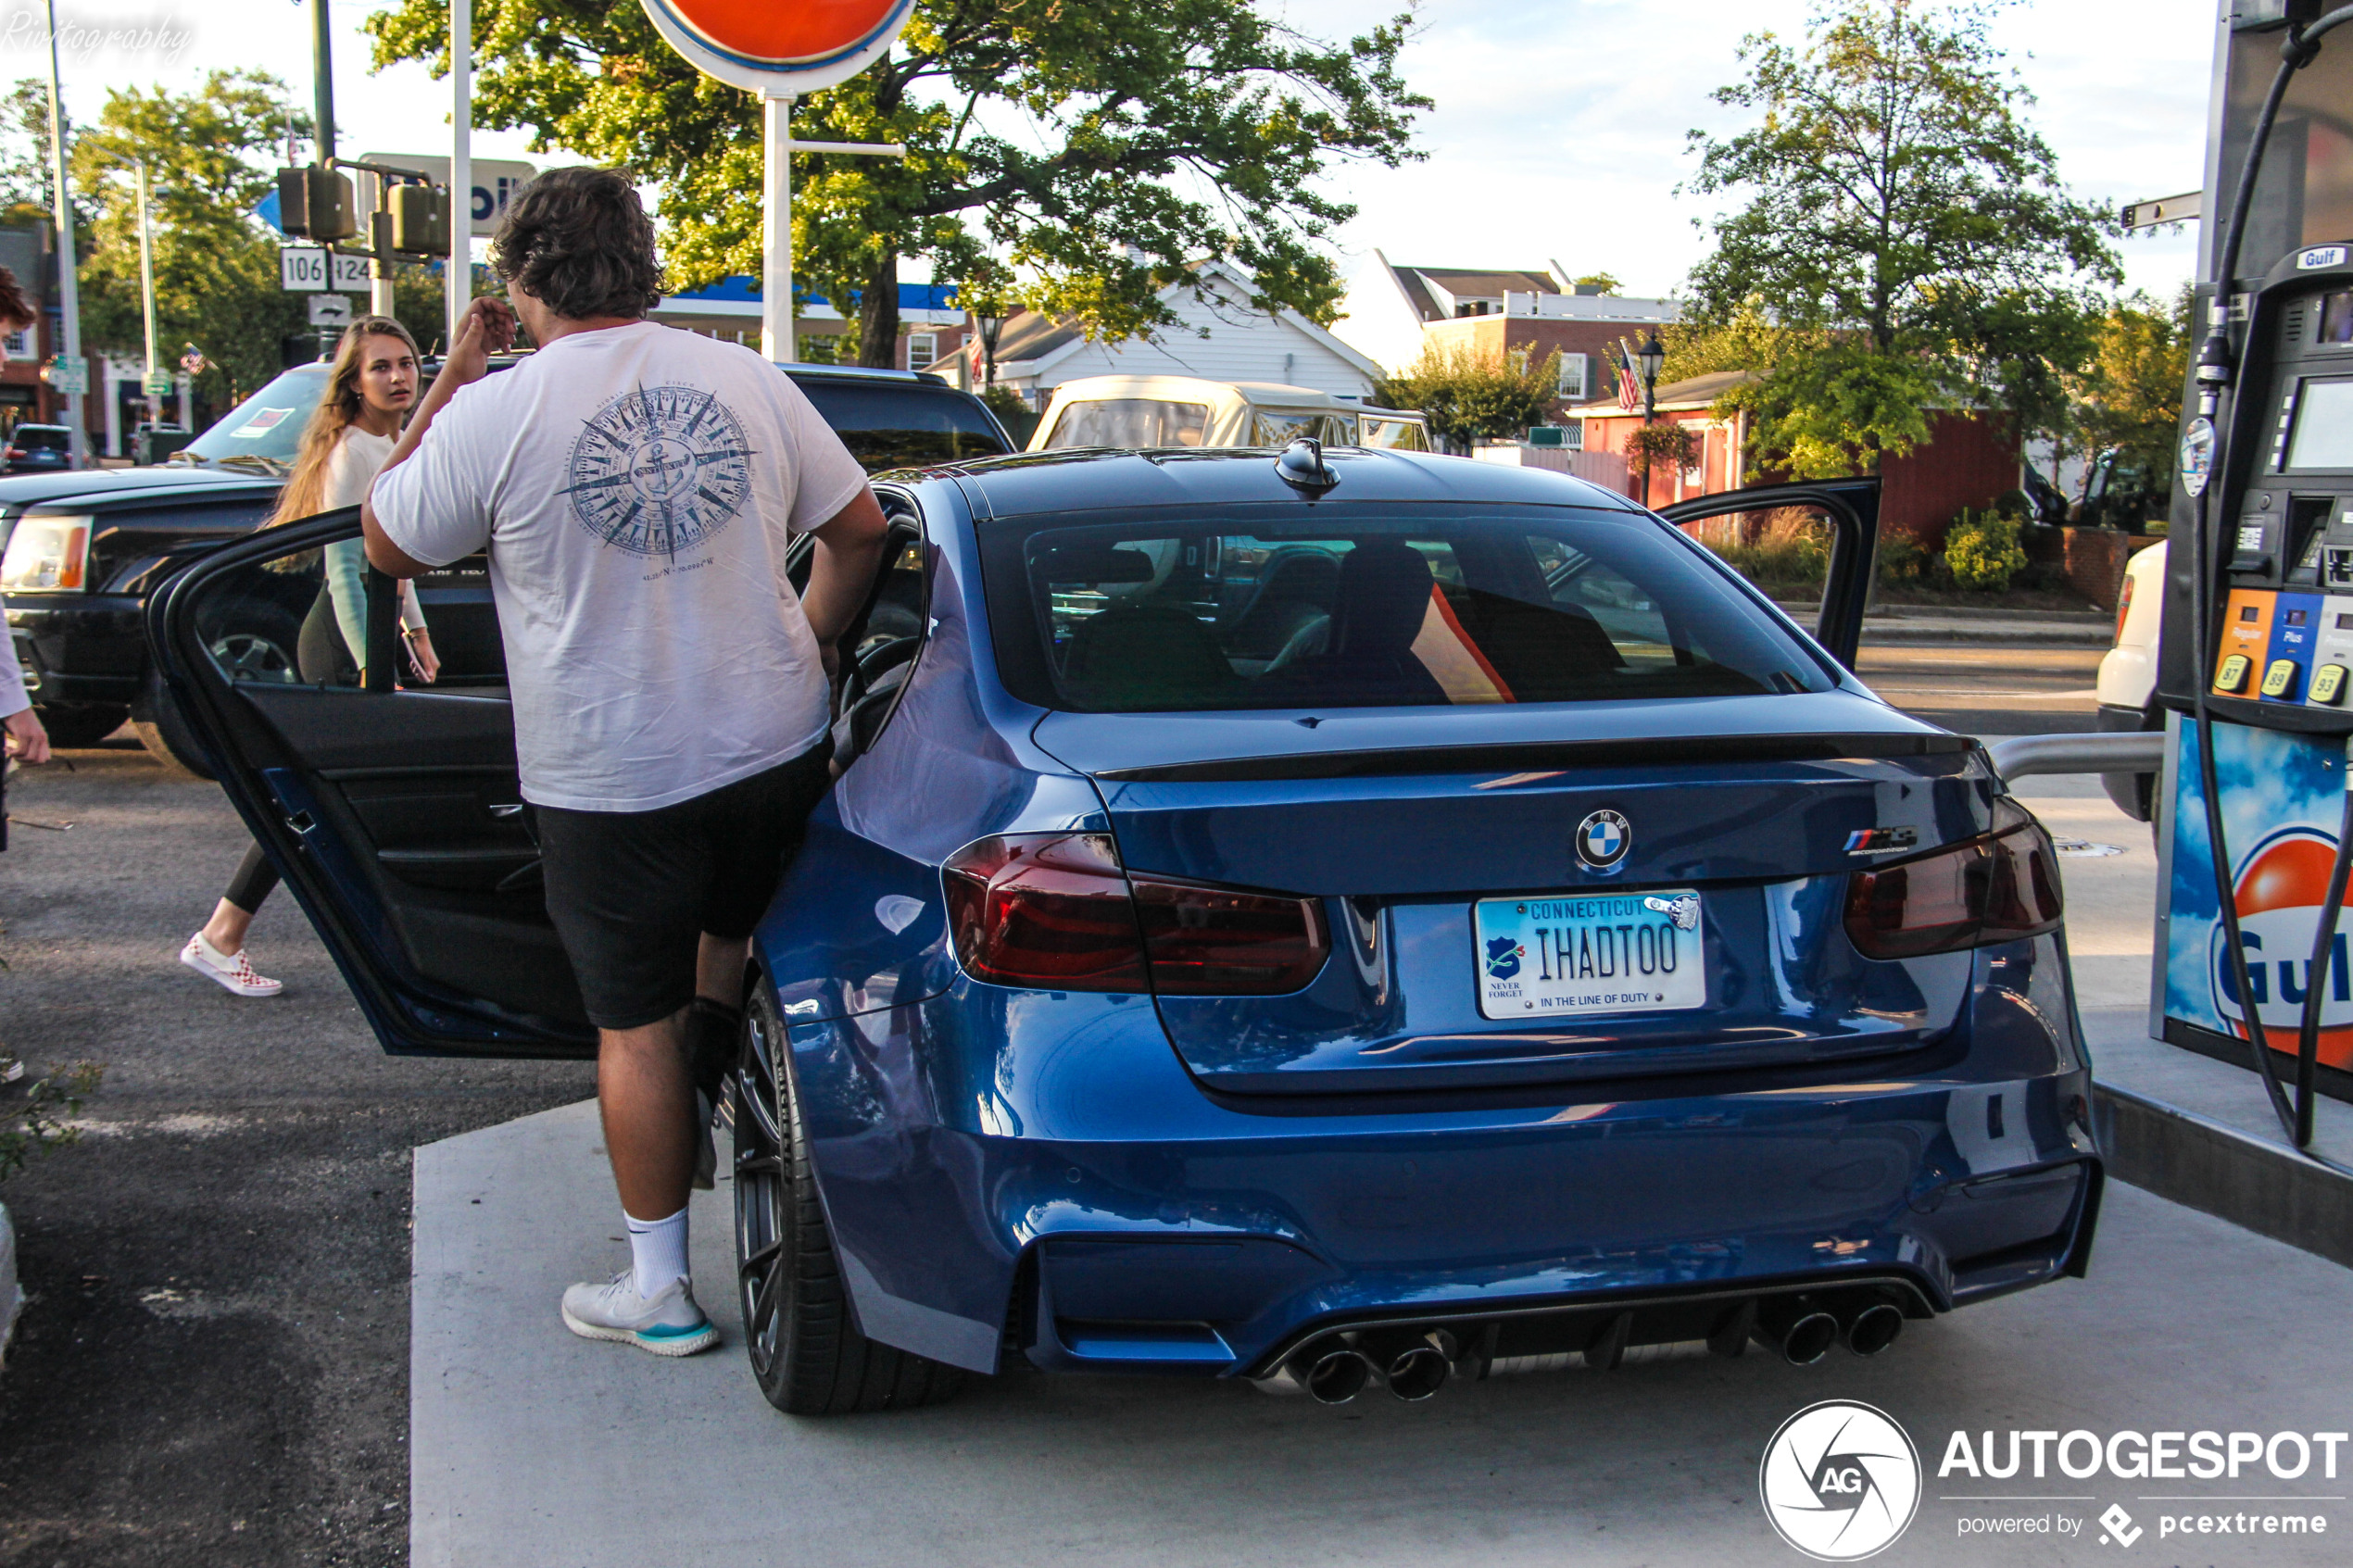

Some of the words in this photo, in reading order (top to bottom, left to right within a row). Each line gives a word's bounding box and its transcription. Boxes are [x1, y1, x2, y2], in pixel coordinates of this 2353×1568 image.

[2306, 250, 2334, 266] Gulf
[288, 257, 322, 282] 106
[337, 259, 369, 280] 124
[626, 445, 638, 458] NW
[2284, 632, 2303, 643] Plus
[2223, 668, 2239, 682] 87
[2269, 673, 2285, 686] 89
[2317, 678, 2334, 693] 93
[1582, 811, 1627, 831] BMW
[1531, 899, 1643, 921] CONNECTICUT
[1534, 922, 1677, 981] IHADTOO
[2219, 931, 2350, 1006] Gul
[1489, 990, 1523, 998] FORGET
[1491, 982, 1520, 990] NEVER
[1541, 997, 1553, 1008] IN
[1555, 996, 1575, 1007] THE
[1579, 995, 1602, 1006] LINE
[1604, 994, 1617, 1004] OF
[1621, 992, 1649, 1003] DUTY
